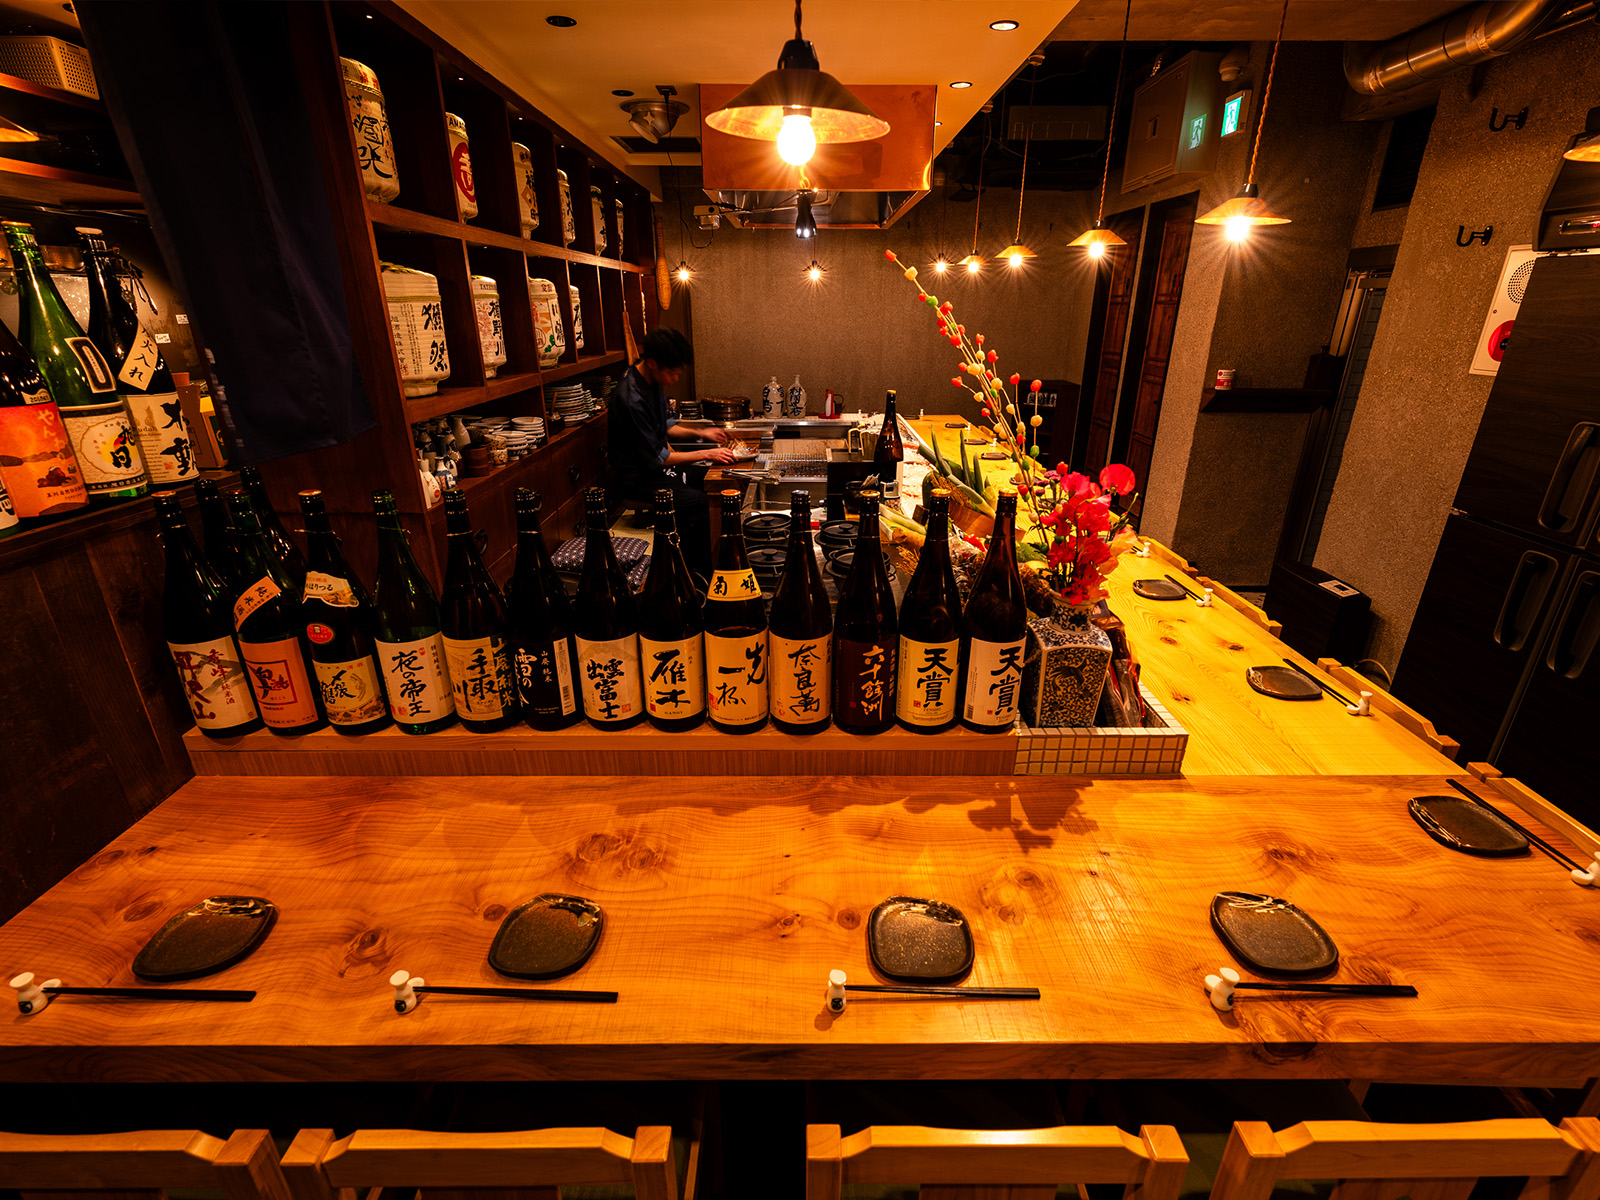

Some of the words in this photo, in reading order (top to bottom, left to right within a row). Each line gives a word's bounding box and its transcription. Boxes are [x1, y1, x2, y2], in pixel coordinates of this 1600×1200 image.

[422, 303, 448, 372] 獺祭
[713, 574, 757, 597] 菊姫
[207, 648, 230, 681] 秀峰
[391, 650, 431, 717] 夜の帝王
[586, 658, 625, 720] 出雲富士
[650, 648, 692, 708] 雁木
[788, 643, 822, 717] 奈良萬
[917, 648, 955, 708] 天賞
[989, 645, 1023, 716] 天賞
